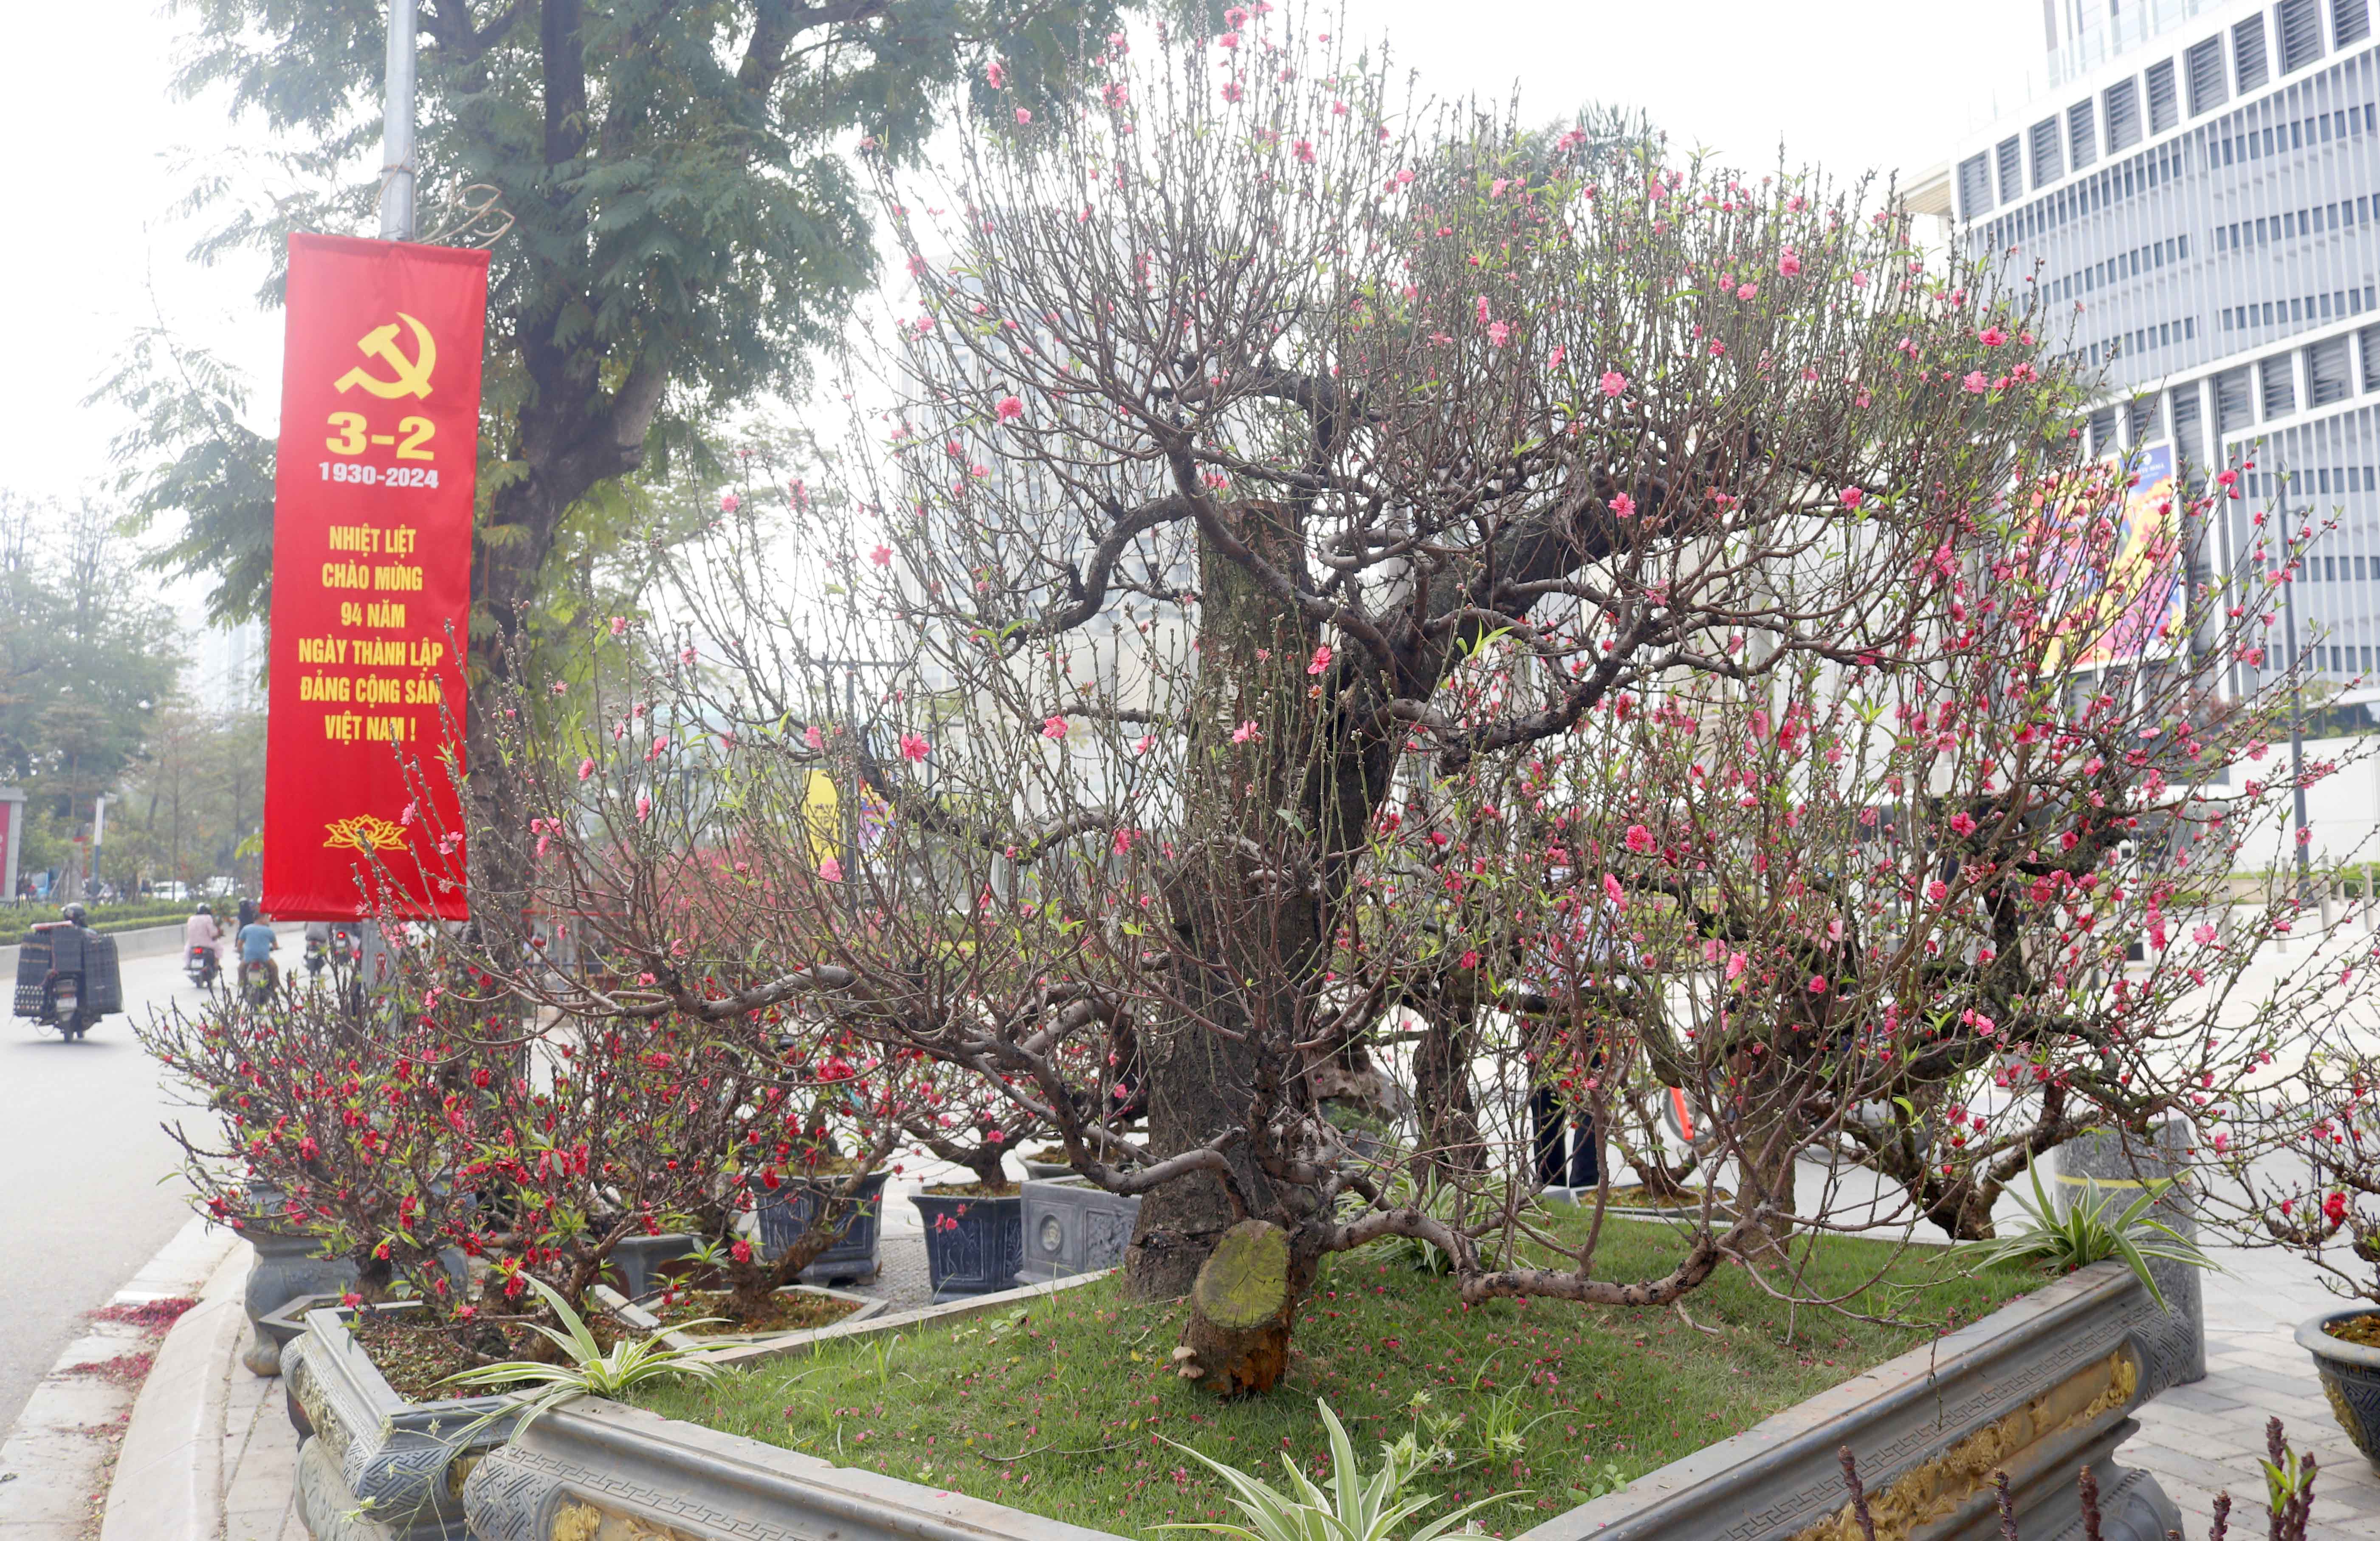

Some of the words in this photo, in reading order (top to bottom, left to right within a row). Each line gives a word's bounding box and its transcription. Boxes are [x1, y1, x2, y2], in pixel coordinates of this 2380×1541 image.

[326, 411, 436, 462] 3-2
[319, 462, 440, 489] 1930-2024
[329, 523, 381, 558] NHIỆT
[385, 524, 417, 559] LIỆT
[322, 559, 370, 590] CHÀO
[375, 561, 423, 591] MỪNG
[341, 601, 362, 627] 94
[367, 599, 406, 629] NĂM
[299, 634, 348, 664] NGÀY
[352, 636, 406, 667] THÀNH
[410, 637, 444, 672] LẬP
[300, 669, 351, 703] ĐẢNG
[355, 673, 400, 709] CỘNG
[405, 672, 442, 705] SẢN
[324, 710, 363, 746] VIỆT
[367, 717, 405, 742] NAM
[410, 717, 417, 742] !
